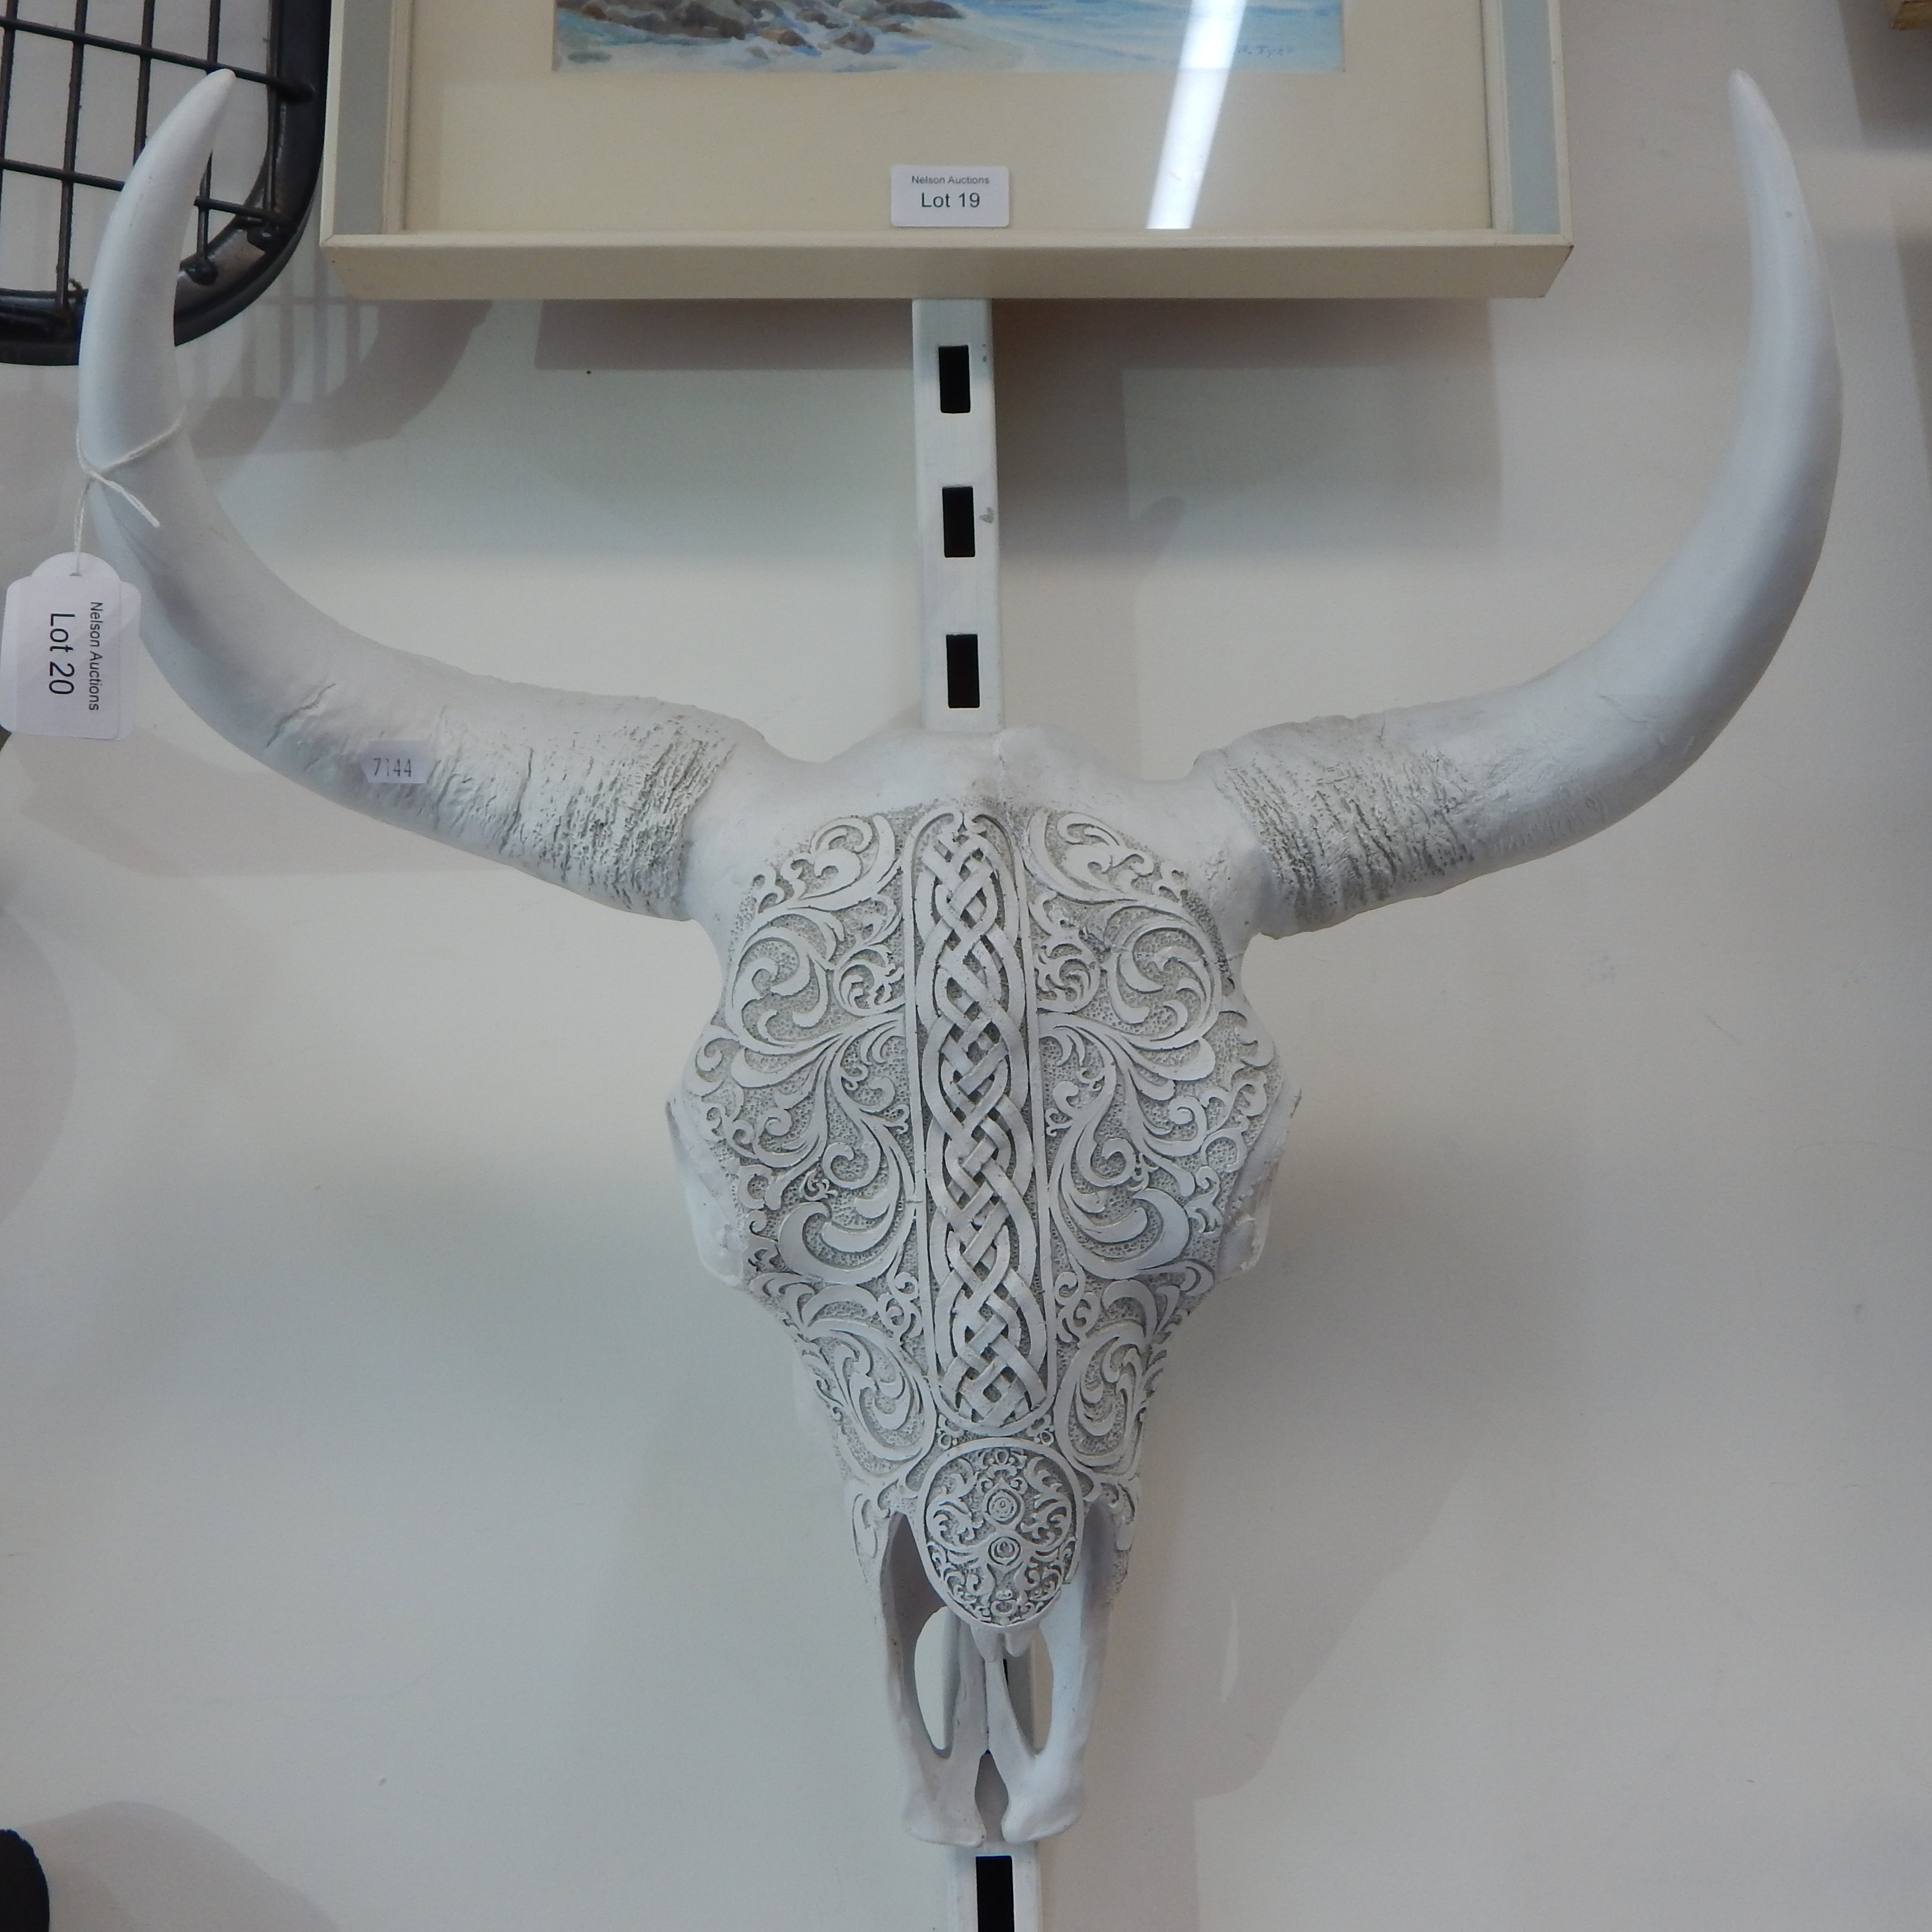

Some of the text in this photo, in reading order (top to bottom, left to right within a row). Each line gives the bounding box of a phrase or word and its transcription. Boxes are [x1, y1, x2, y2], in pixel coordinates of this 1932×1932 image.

[912, 176, 989, 184] Nelson Auctions
[921, 192, 980, 207] Lot 19
[49, 613, 75, 694] Lot 20
[89, 601, 103, 711] Nelson Auctions
[373, 757, 411, 777] 7144
